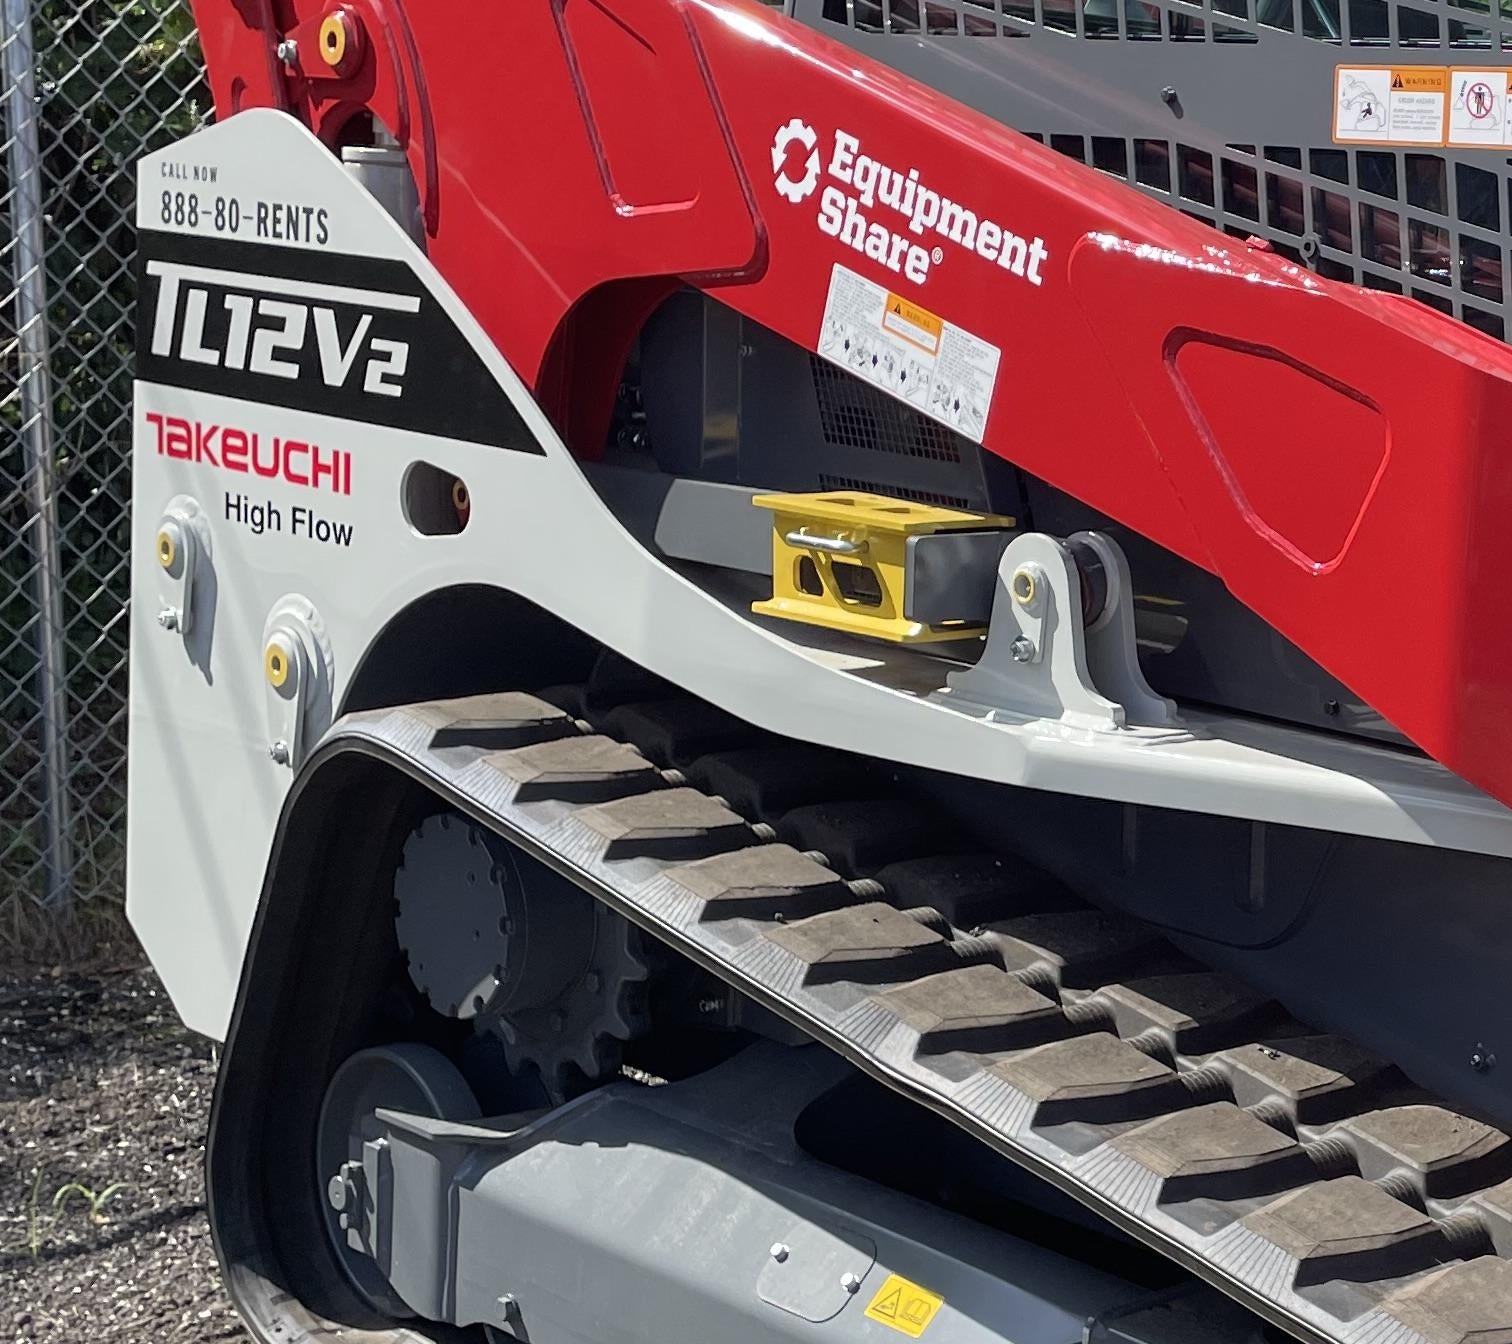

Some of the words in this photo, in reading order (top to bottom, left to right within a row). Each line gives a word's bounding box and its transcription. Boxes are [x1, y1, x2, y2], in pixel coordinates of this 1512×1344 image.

[161, 161, 188, 182] CALL
[193, 165, 218, 184] NOW
[161, 190, 329, 245] 888-80-RENTS
[828, 129, 1048, 286] Equipment
[145, 413, 352, 496] TAKEUCHI
[224, 491, 282, 535] High
[291, 508, 354, 547] Flow
